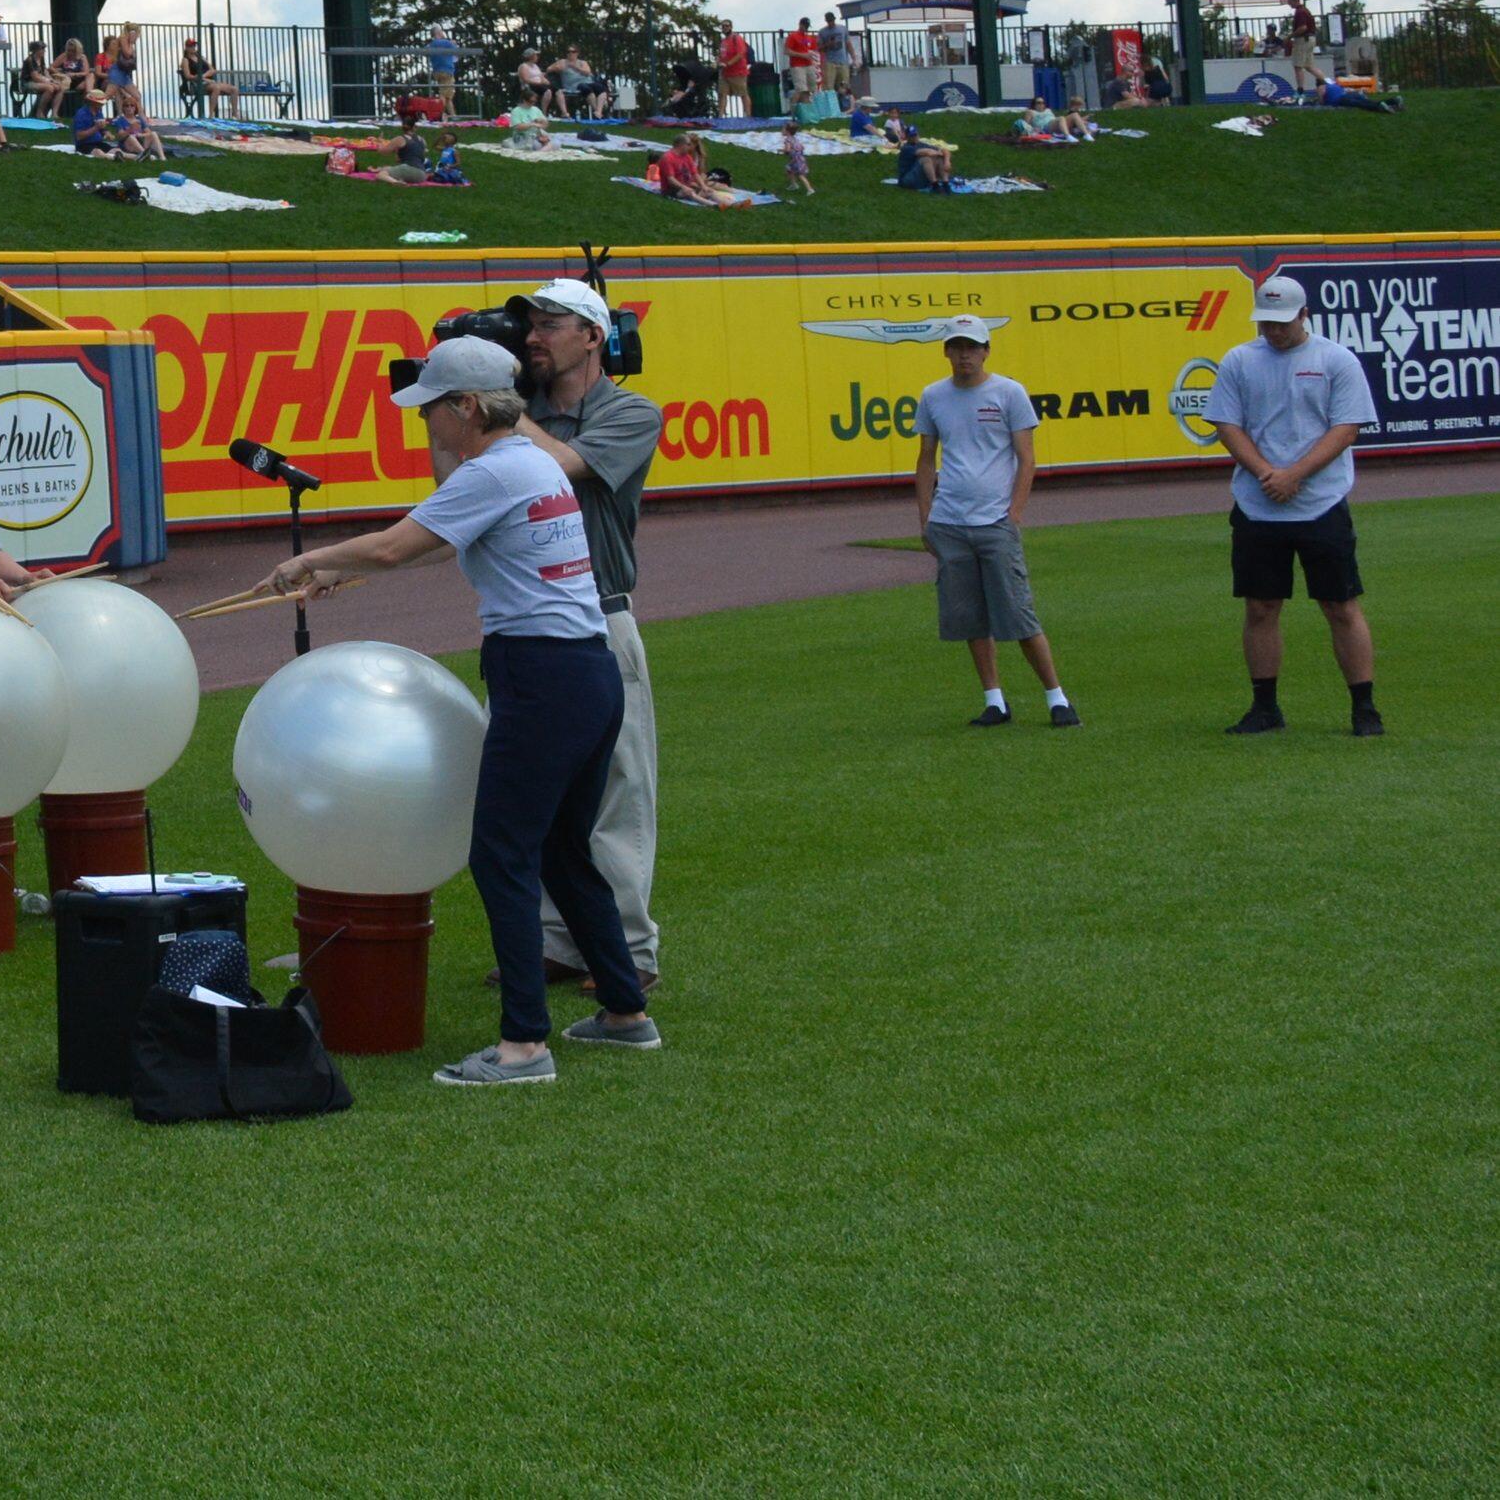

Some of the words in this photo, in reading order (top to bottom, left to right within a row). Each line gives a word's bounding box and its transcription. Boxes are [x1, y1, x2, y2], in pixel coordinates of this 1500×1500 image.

[826, 293, 983, 310] CHRYSLER
[1030, 300, 1203, 322] DODGE
[1320, 278, 1361, 310] on
[1368, 276, 1438, 318] your
[1381, 349, 1500, 402] team
[830, 382, 918, 441] Jee
[1029, 389, 1150, 422] RAM
[1176, 390, 1208, 410] NISS
[1386, 419, 1429, 433] PLUMBING
[1434, 416, 1484, 430] SHEETMETAL
[34, 481, 41, 493] &
[45, 479, 77, 493] BATHS
